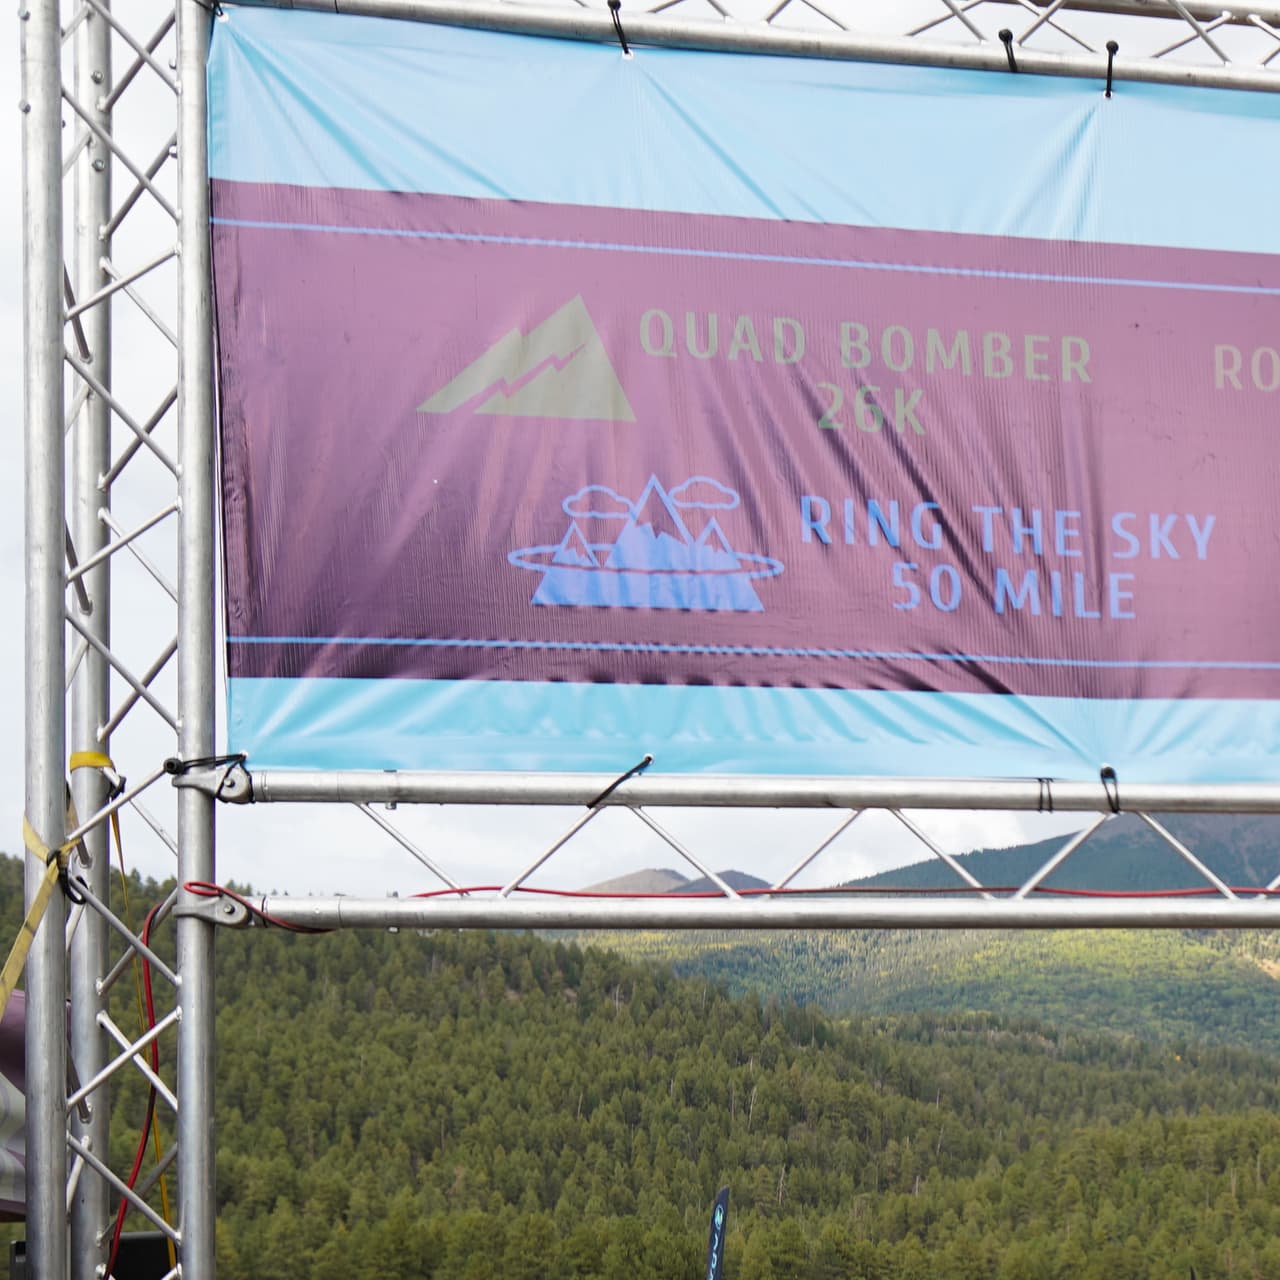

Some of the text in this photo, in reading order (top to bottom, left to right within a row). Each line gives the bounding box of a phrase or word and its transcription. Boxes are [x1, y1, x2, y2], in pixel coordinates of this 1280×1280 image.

[639, 308, 1093, 383] QUAD BOMBER
[817, 383, 927, 435] 26K
[800, 496, 1217, 561] RING THE SKY
[893, 563, 1136, 619] 50 MILE
